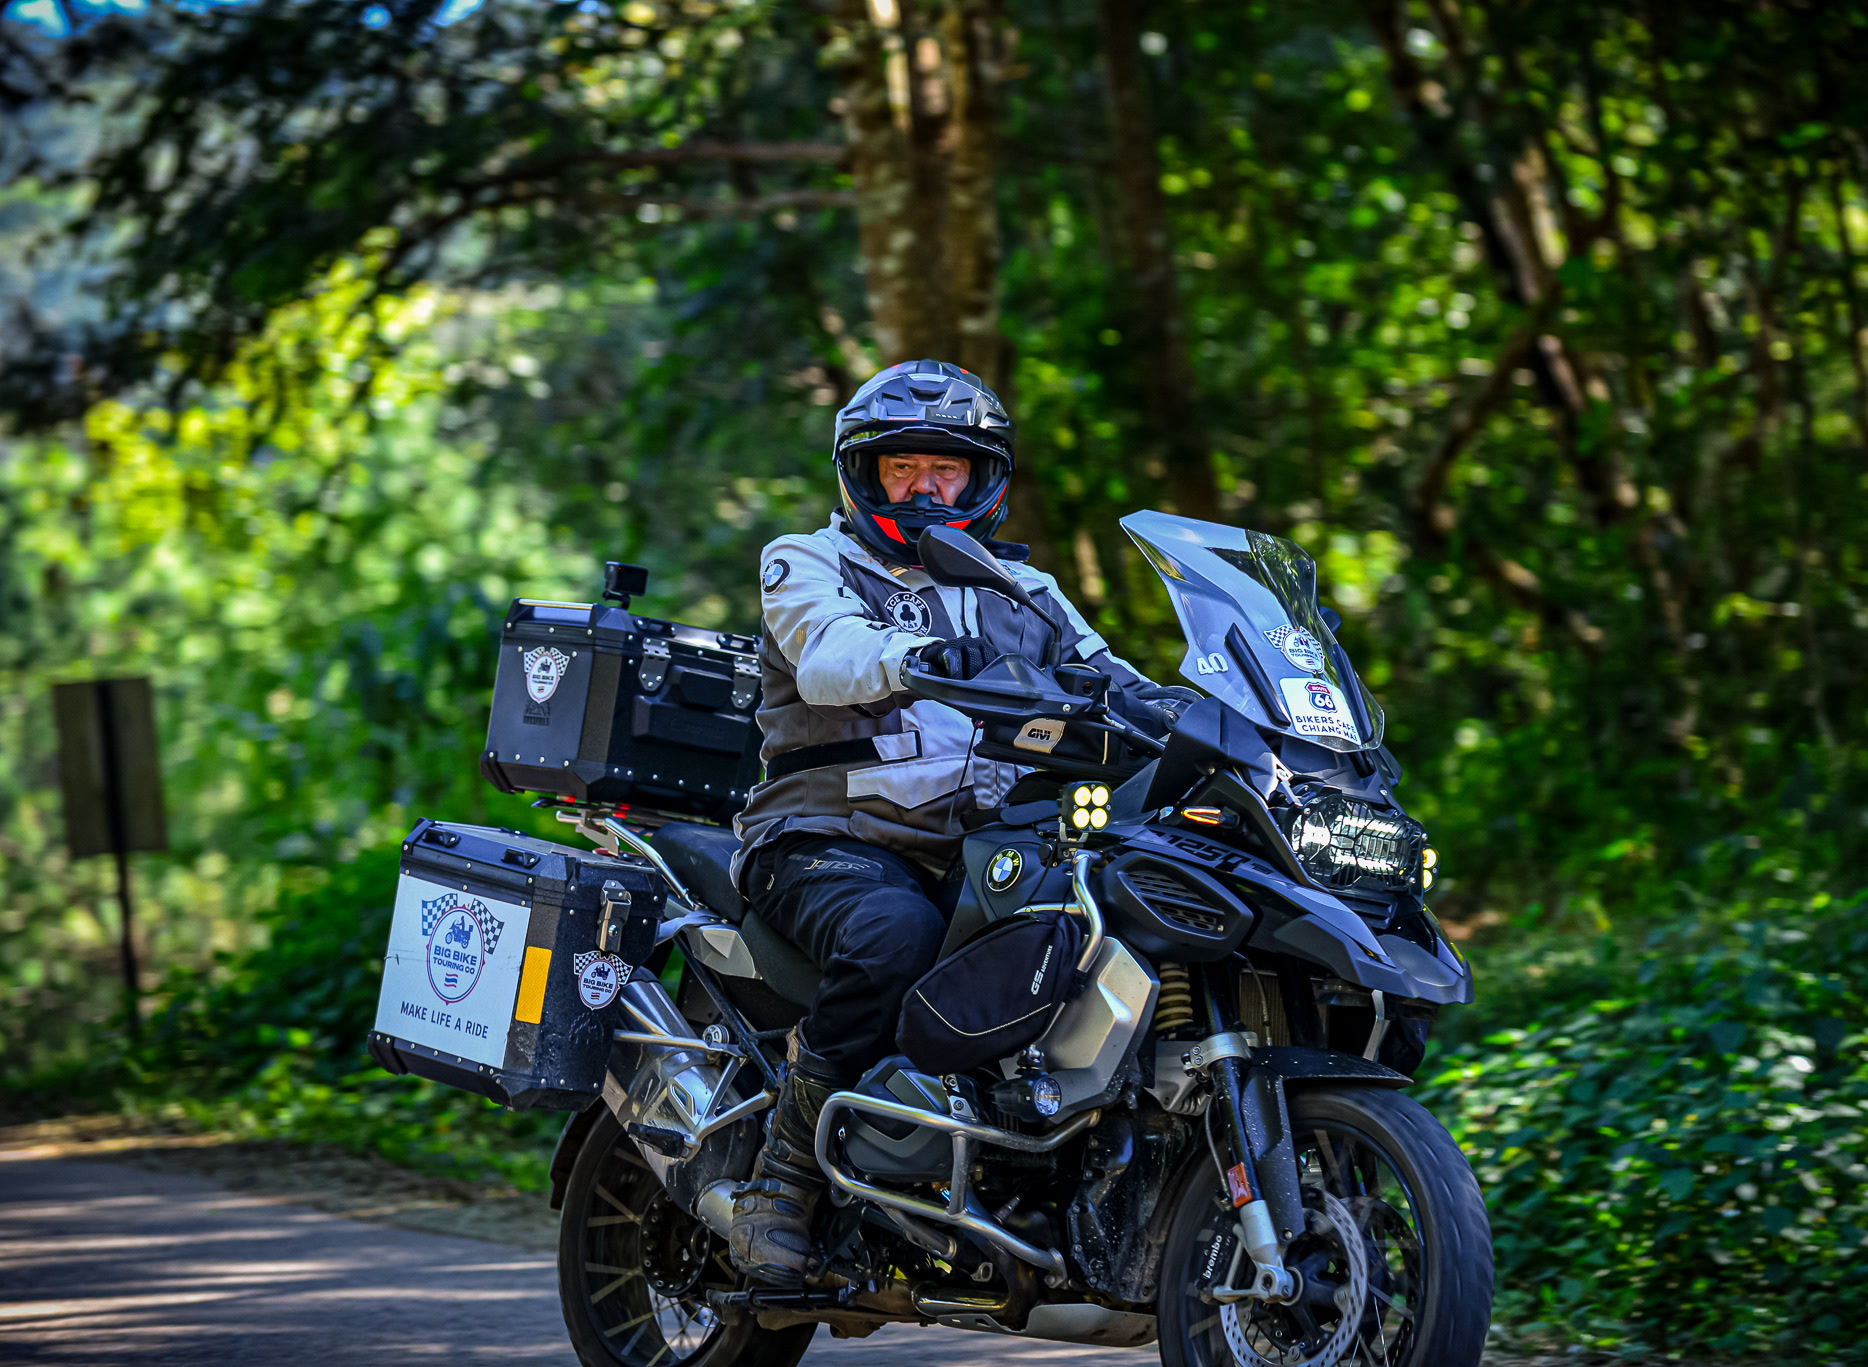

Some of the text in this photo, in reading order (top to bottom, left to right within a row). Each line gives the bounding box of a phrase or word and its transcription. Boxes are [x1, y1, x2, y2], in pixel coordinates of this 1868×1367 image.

[886, 594, 926, 612] ACE CAFE
[1197, 652, 1229, 675] 40
[1315, 693, 1335, 709] 66
[1295, 715, 1334, 725] BIKERS
[1027, 727, 1052, 741] GIVI
[1302, 724, 1342, 735] CHIANG
[997, 850, 1020, 867] BMW
[1168, 834, 1252, 872] 1250
[434, 945, 477, 967] BIG BIKE
[433, 956, 475, 975] TOURING CO
[1030, 945, 1053, 995] GS ADVENTURE
[583, 977, 614, 989] BIG BIKE
[583, 983, 604, 992] TOURING
[400, 1000, 489, 1039] MAKE LIFE A RIDE
[1202, 1235, 1223, 1279] brembo
